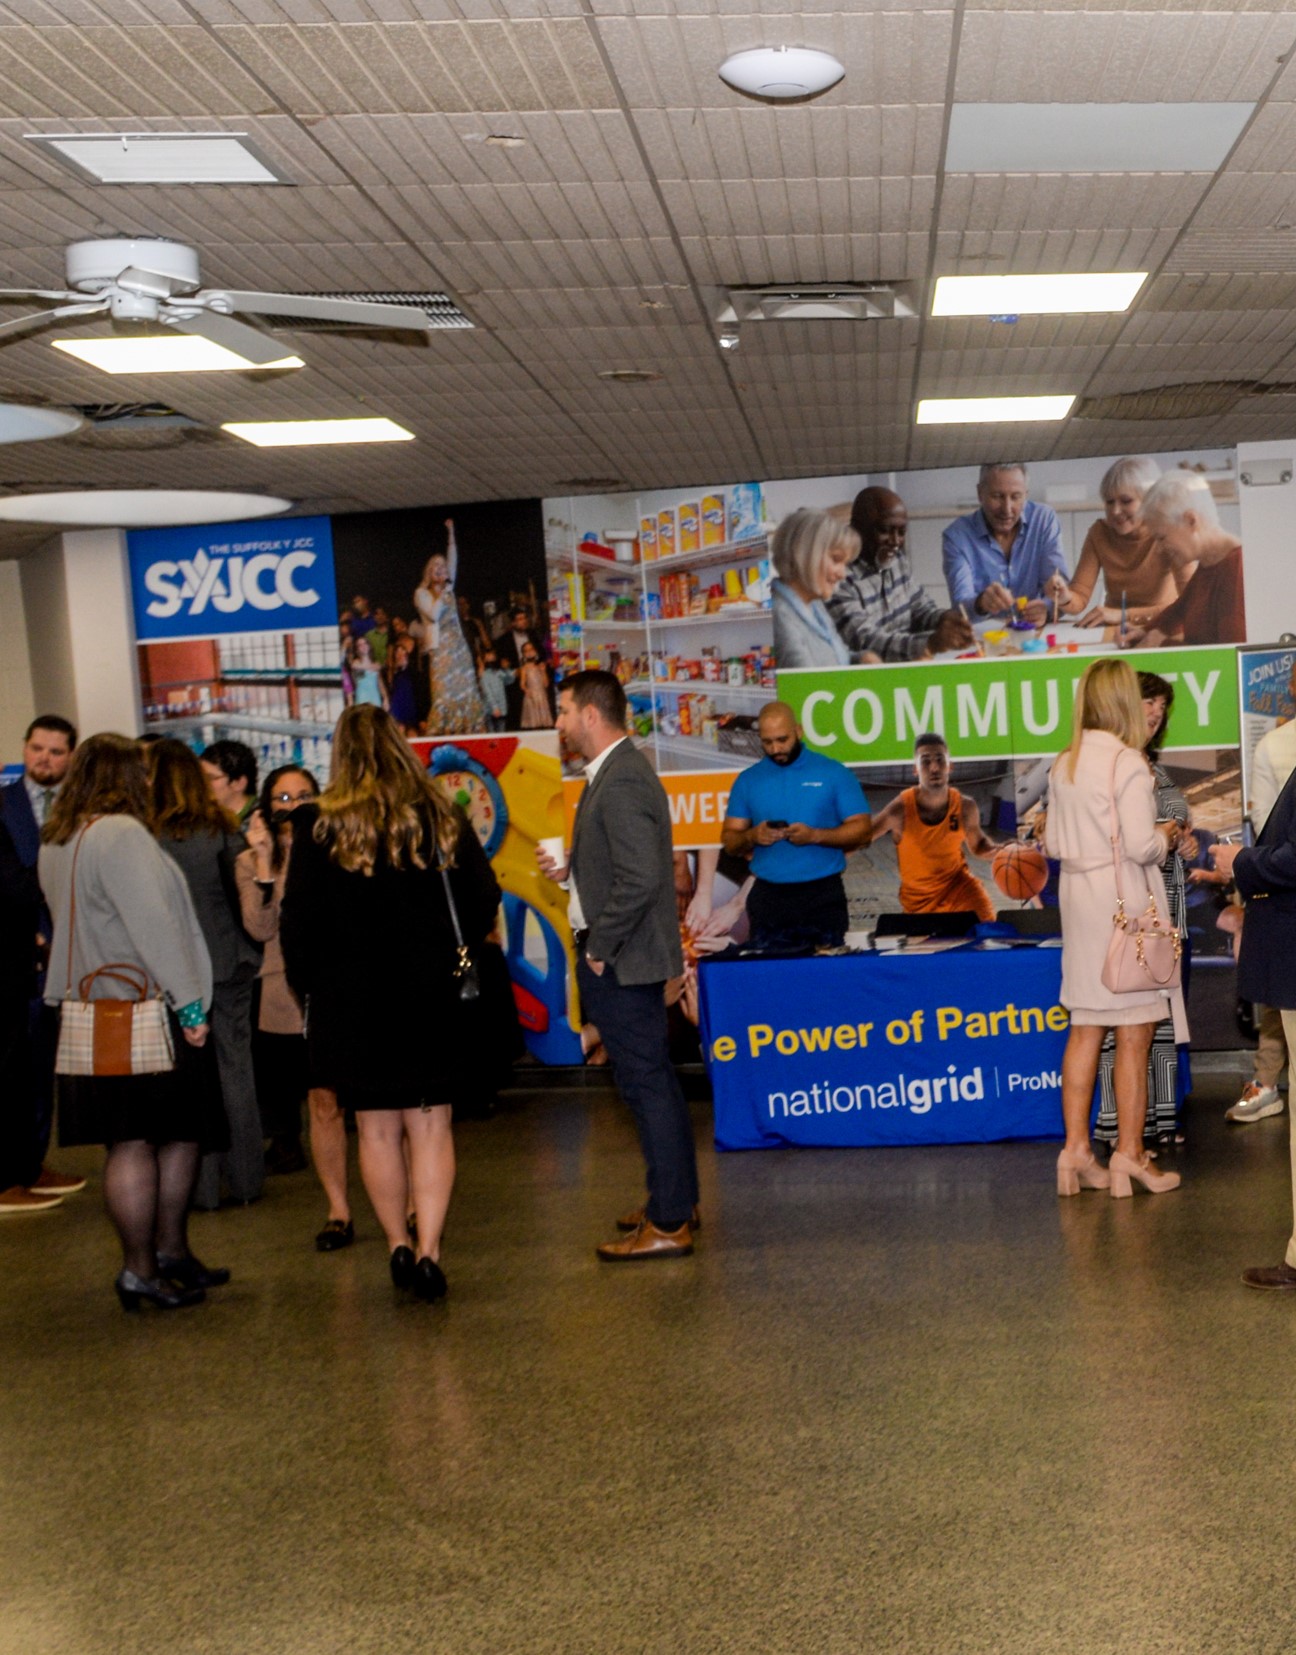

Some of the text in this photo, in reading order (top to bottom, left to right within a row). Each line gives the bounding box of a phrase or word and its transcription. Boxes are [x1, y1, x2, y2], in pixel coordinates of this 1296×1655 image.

[209, 544, 230, 554] THE
[232, 541, 281, 553] SUFFOLK
[1248, 663, 1274, 686] JOIN
[1275, 655, 1294, 673] US!
[802, 670, 1221, 746] COMMUY
[748, 1022, 873, 1058] Power
[886, 1010, 925, 1045] of
[936, 1003, 1069, 1040] Partne
[768, 1064, 1062, 1119] nationalgrid ProN
